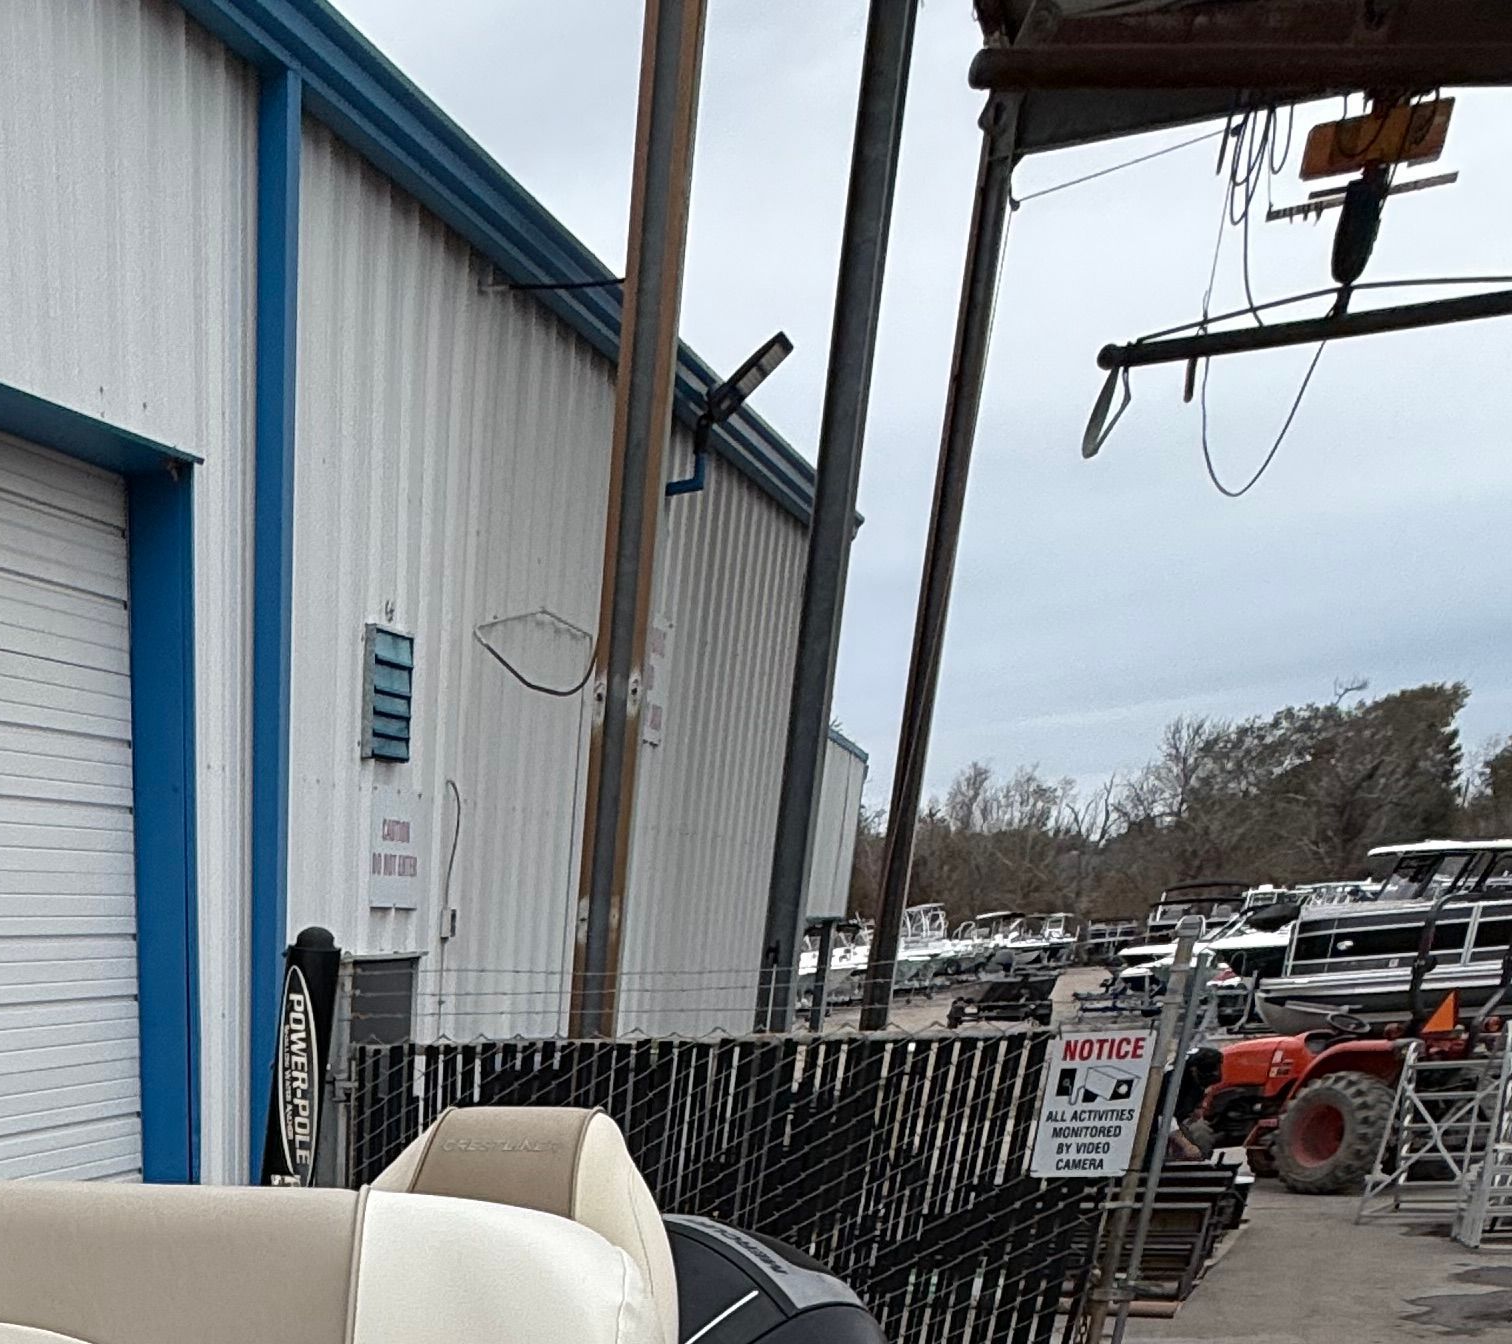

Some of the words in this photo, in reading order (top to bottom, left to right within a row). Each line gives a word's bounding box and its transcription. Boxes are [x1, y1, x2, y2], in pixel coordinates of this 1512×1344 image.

[1062, 1036, 1146, 1062] NOTICE
[289, 993, 311, 1165] POWER-POLE
[1045, 1111, 1066, 1122] ALL
[1070, 1109, 1135, 1122] ACTIVITIES
[1051, 1125, 1122, 1138] MONITORED
[1056, 1142, 1071, 1155] BY
[1076, 1142, 1110, 1154] VIDEO
[1055, 1158, 1104, 1171] CAMERA
